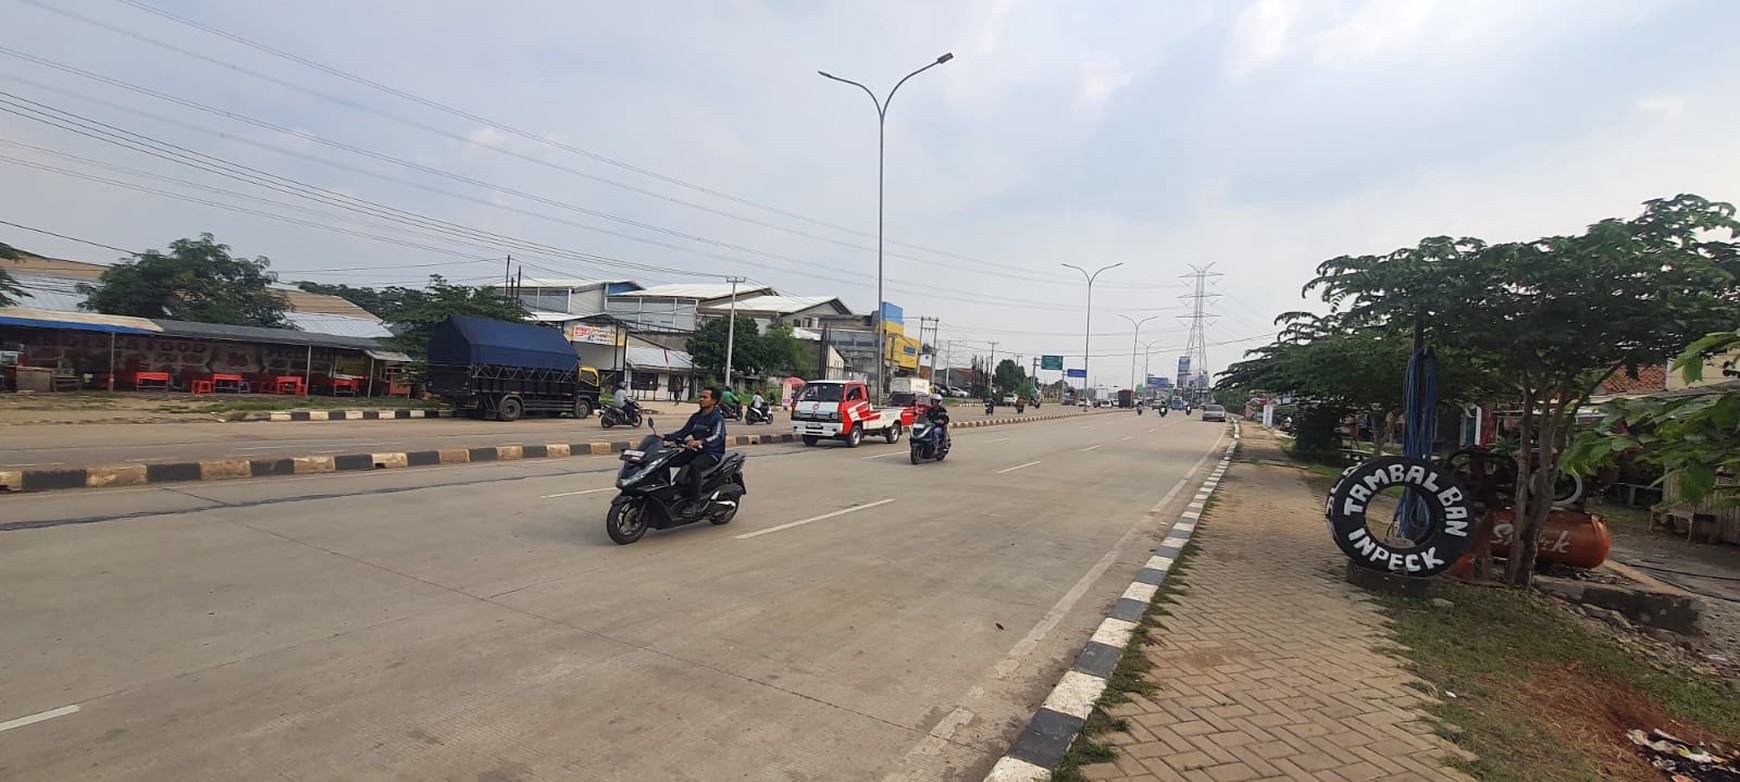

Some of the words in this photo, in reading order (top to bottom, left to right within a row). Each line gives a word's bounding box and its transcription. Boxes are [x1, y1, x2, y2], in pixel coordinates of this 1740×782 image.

[1343, 463, 1440, 516] TAMBAL
[1437, 486, 1470, 538] BAN
[1348, 527, 1445, 572] INPECK
